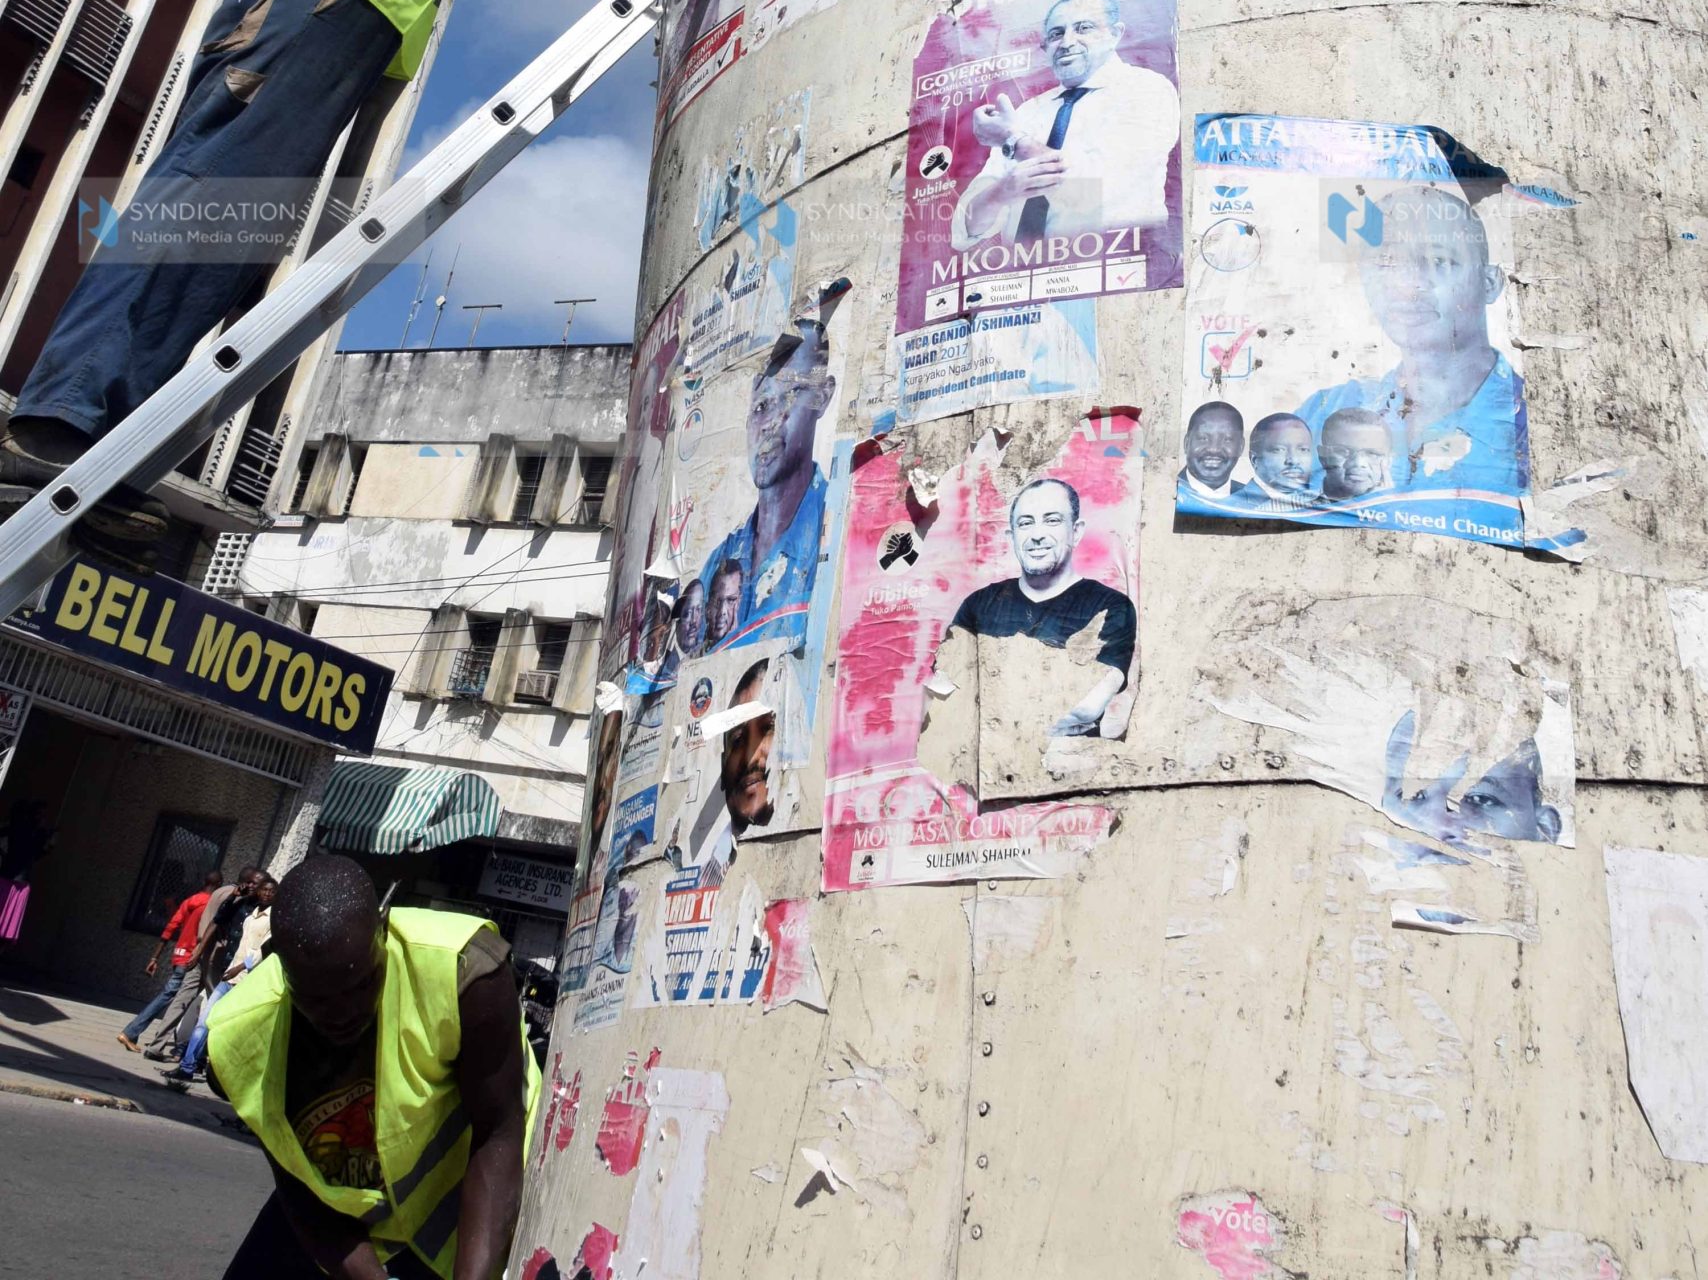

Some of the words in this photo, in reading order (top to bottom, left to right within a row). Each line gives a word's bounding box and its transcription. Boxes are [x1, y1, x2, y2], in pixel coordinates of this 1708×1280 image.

[921, 53, 1026, 91] GOVERNOR
[941, 84, 989, 110] 2017
[912, 179, 957, 199] Jubilee
[1209, 200, 1254, 212] NASA
[932, 226, 1141, 285] MKOMBOZI
[905, 334, 929, 352] MCA
[904, 350, 937, 369] WARD
[941, 343, 968, 360] 2017
[925, 368, 946, 384] yako
[974, 356, 995, 371] yako
[903, 379, 968, 404] Independent
[1357, 508, 1388, 522] We
[1395, 511, 1446, 529] Need
[1454, 519, 1523, 542] Change
[864, 583, 930, 607] Jubilee
[55, 562, 176, 666] BELL
[186, 613, 366, 732] MOTORS
[926, 851, 978, 868] SULEIMAN
[495, 873, 538, 892] AGENCIES
[544, 882, 563, 898] LTD.
[527, 863, 574, 886] INSURANCE
